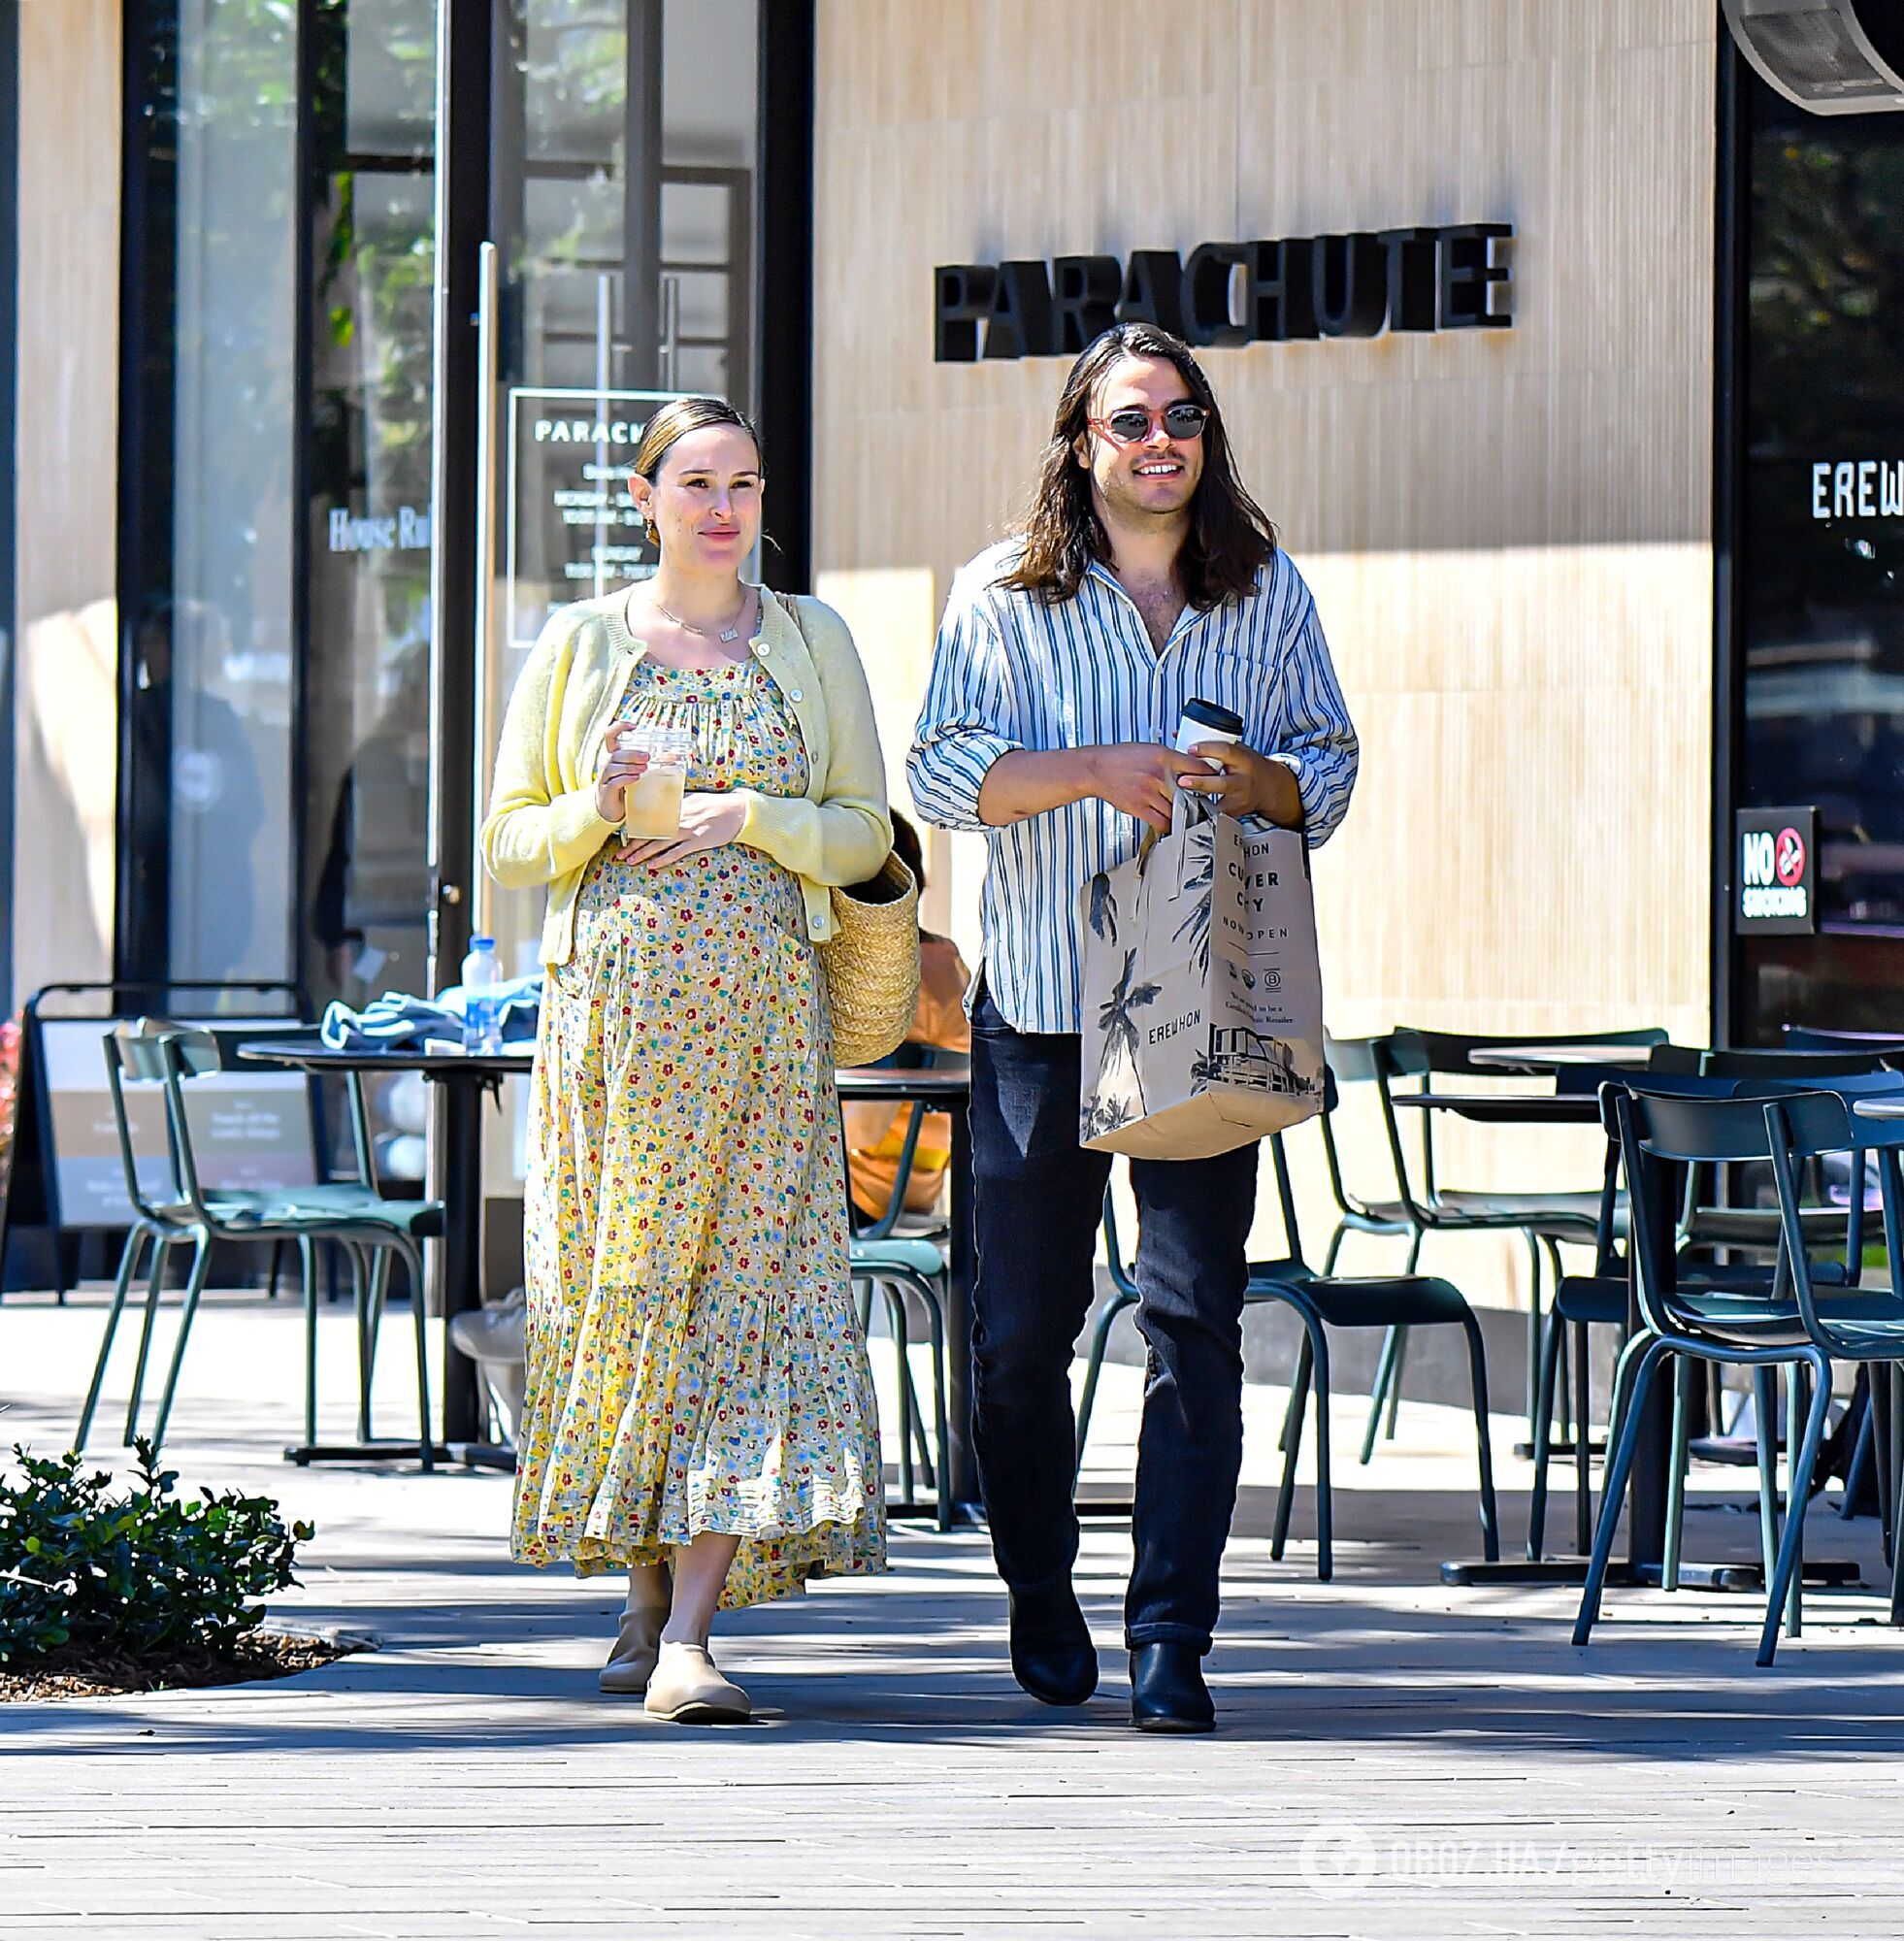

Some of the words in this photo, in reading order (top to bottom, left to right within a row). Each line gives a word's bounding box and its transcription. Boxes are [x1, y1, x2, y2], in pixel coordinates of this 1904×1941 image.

[934, 223, 1513, 363] PARACHUTE
[1228, 862, 1279, 890] CUVER
[1742, 832, 1775, 886] NO
[1148, 1007, 1201, 1045] EREWHON
